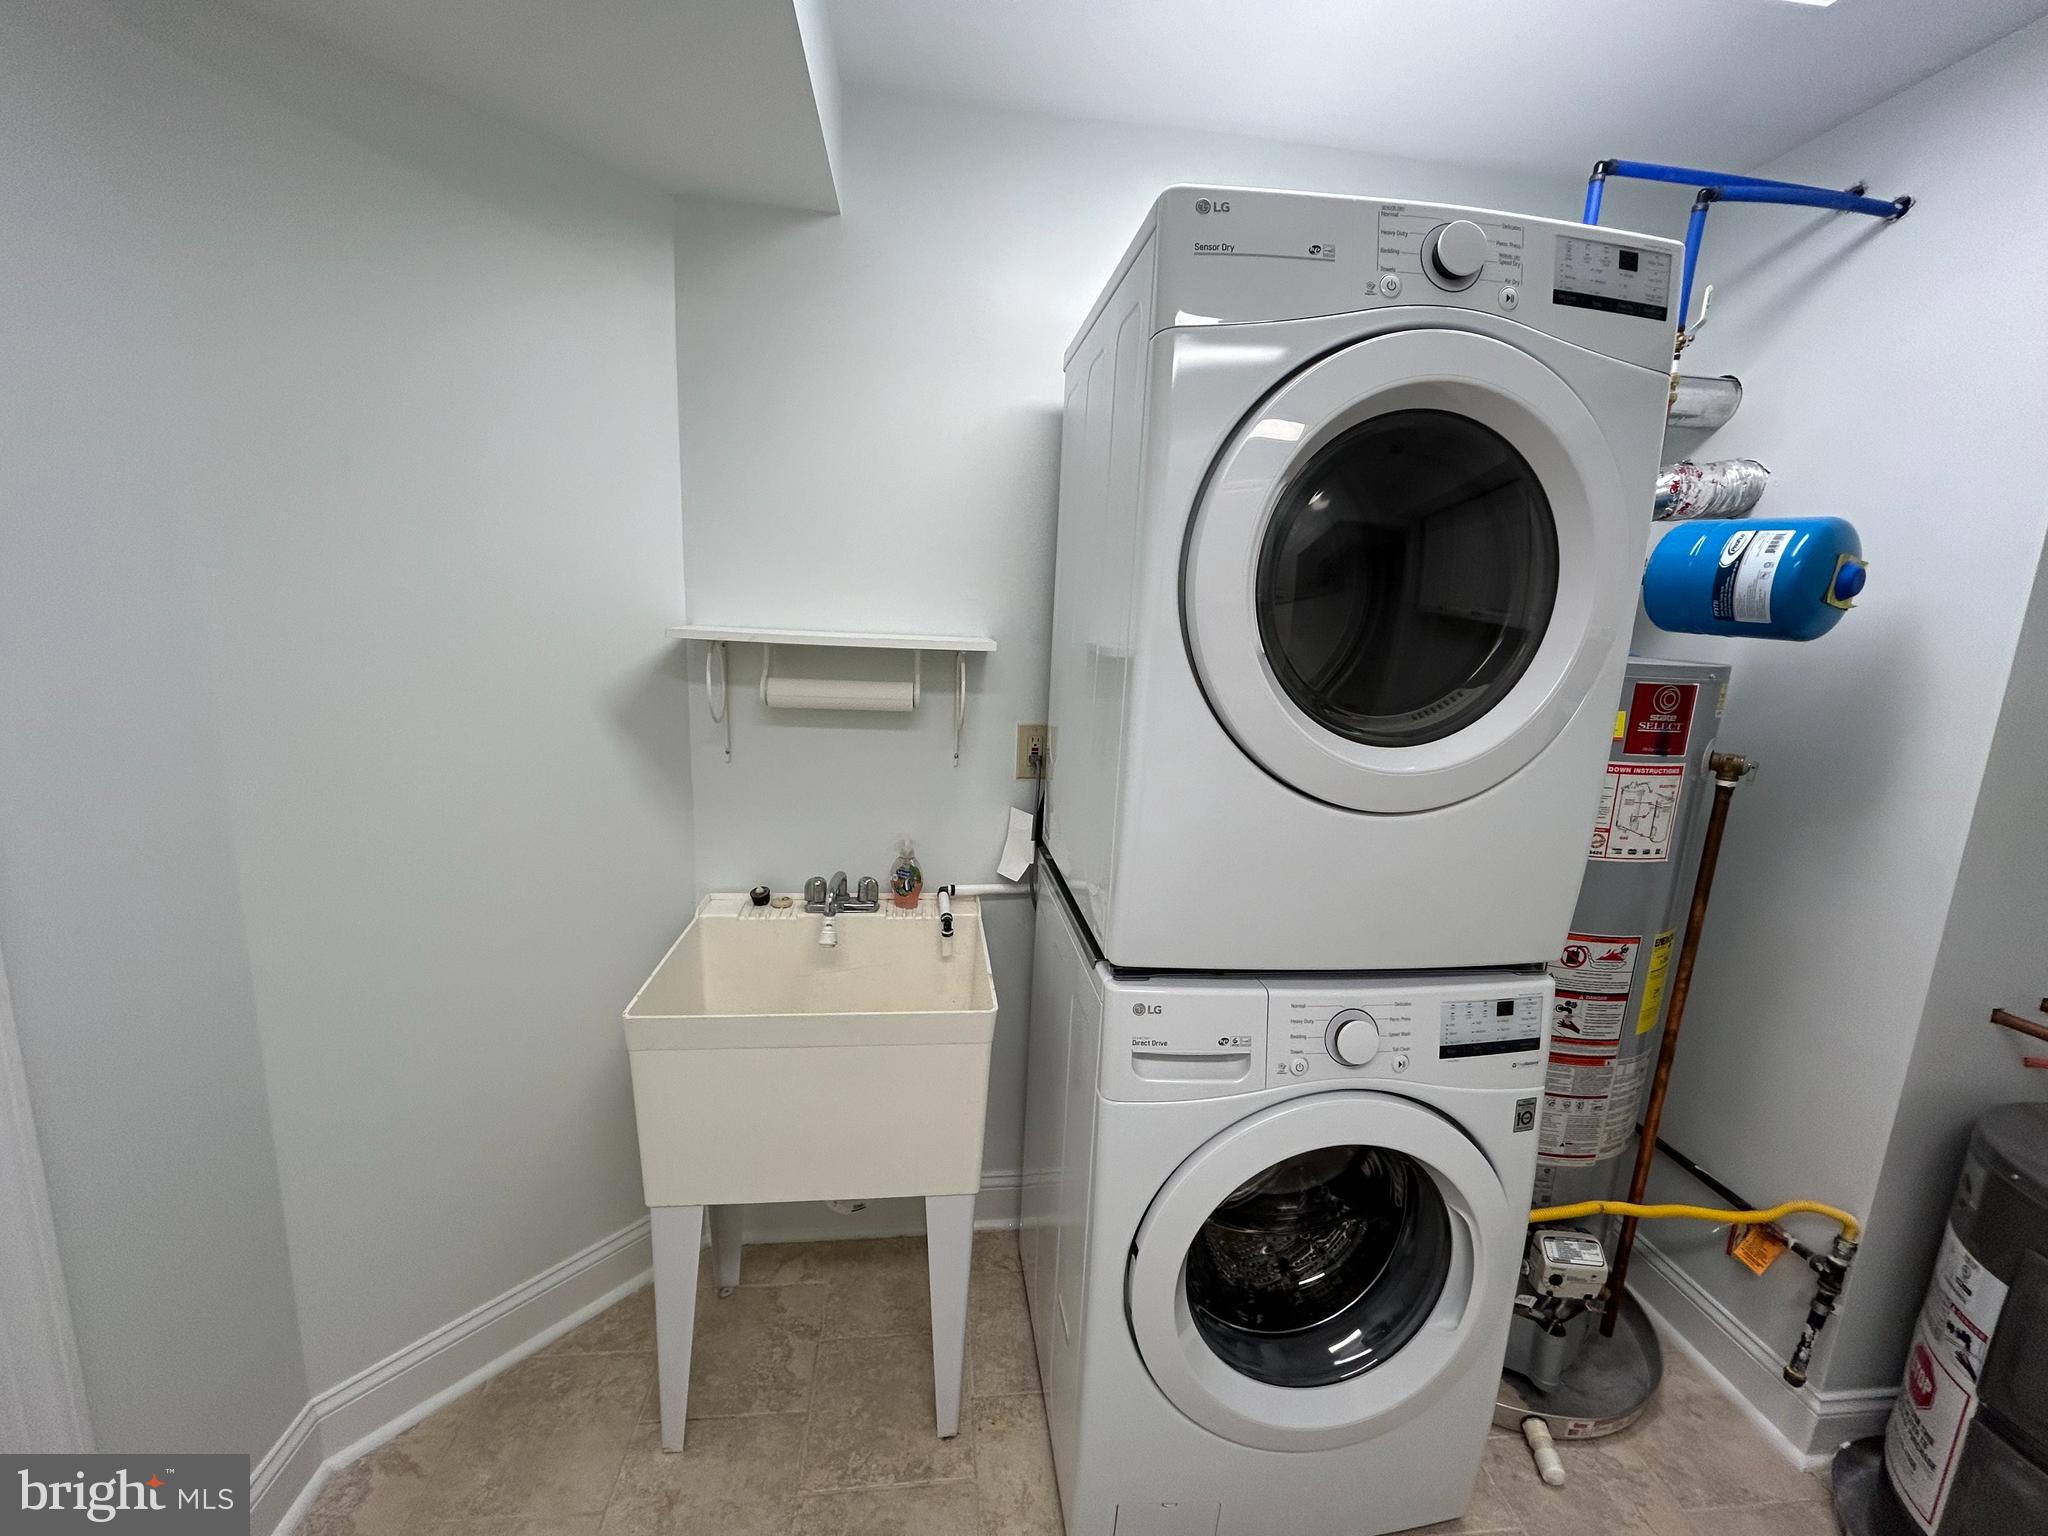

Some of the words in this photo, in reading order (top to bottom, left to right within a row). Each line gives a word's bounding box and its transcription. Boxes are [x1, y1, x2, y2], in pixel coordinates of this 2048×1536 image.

[1213, 201, 1230, 213] LG
[1396, 230, 1408, 238] Duty
[1194, 242, 1220, 251] Sensor
[1222, 243, 1235, 253] Dry
[1638, 721, 1684, 730] SELECT
[1147, 1005, 1162, 1015] LG
[1132, 1039, 1150, 1047] Direct
